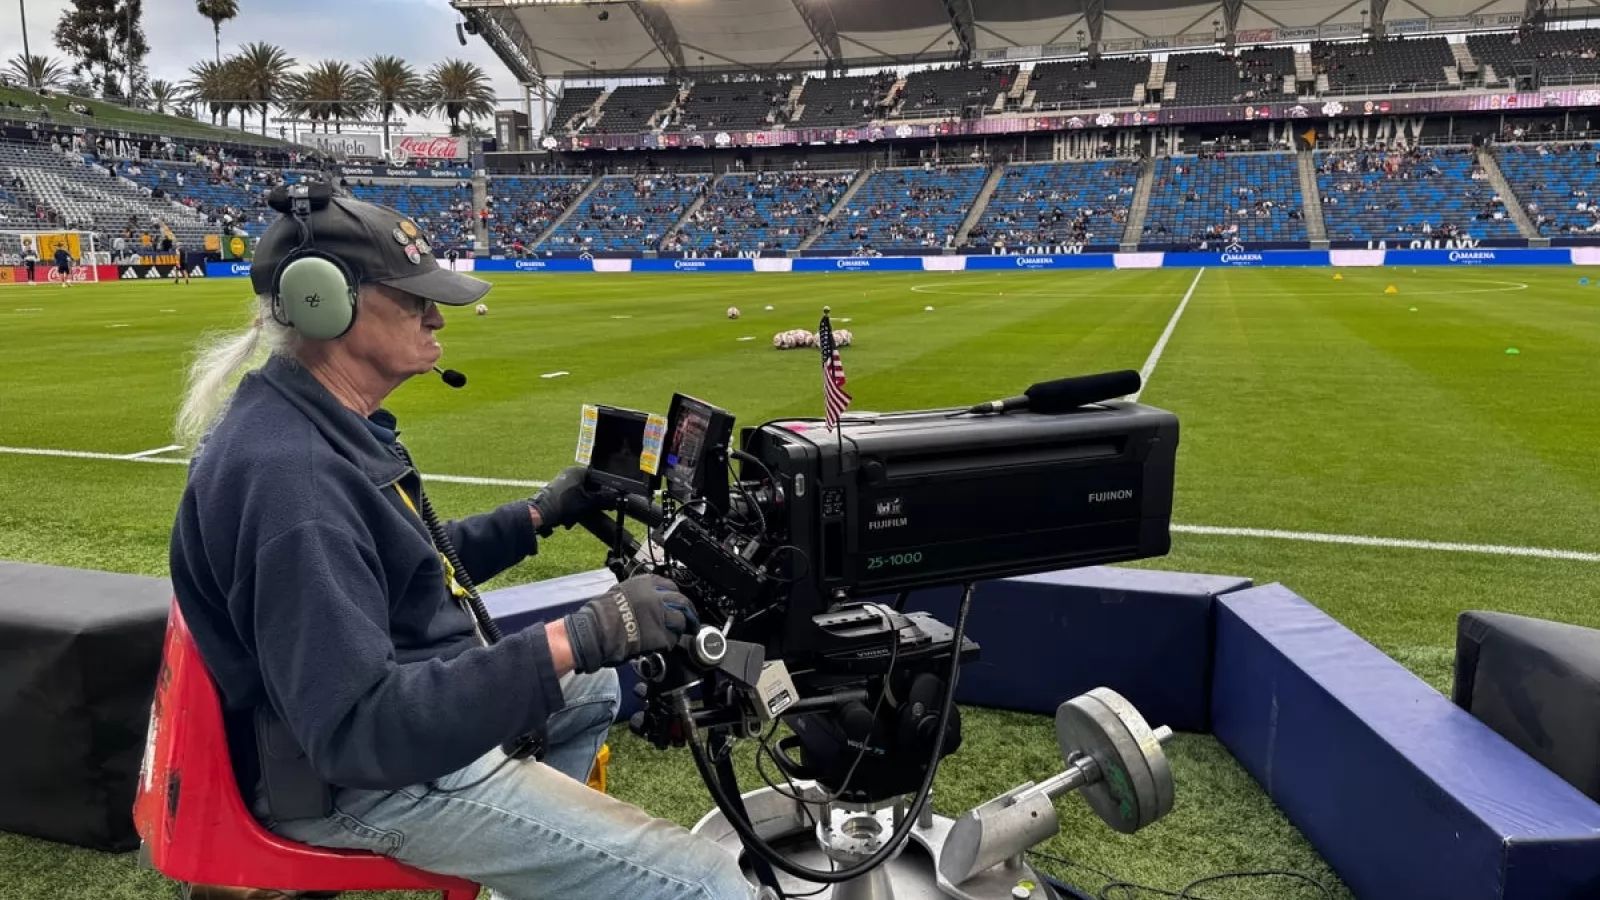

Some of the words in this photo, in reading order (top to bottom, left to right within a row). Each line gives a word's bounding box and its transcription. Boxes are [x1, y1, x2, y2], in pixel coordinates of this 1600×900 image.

[317, 137, 365, 157] Modelo
[341, 167, 374, 176] Spectrum
[386, 168, 418, 177] Spectrum
[1220, 253, 1263, 263] CAMARENA
[1448, 250, 1496, 262] CAMARENA
[1088, 489, 1133, 503] FUJINON
[868, 517, 908, 530] FUJIFILM
[867, 551, 923, 569] 25-1000
